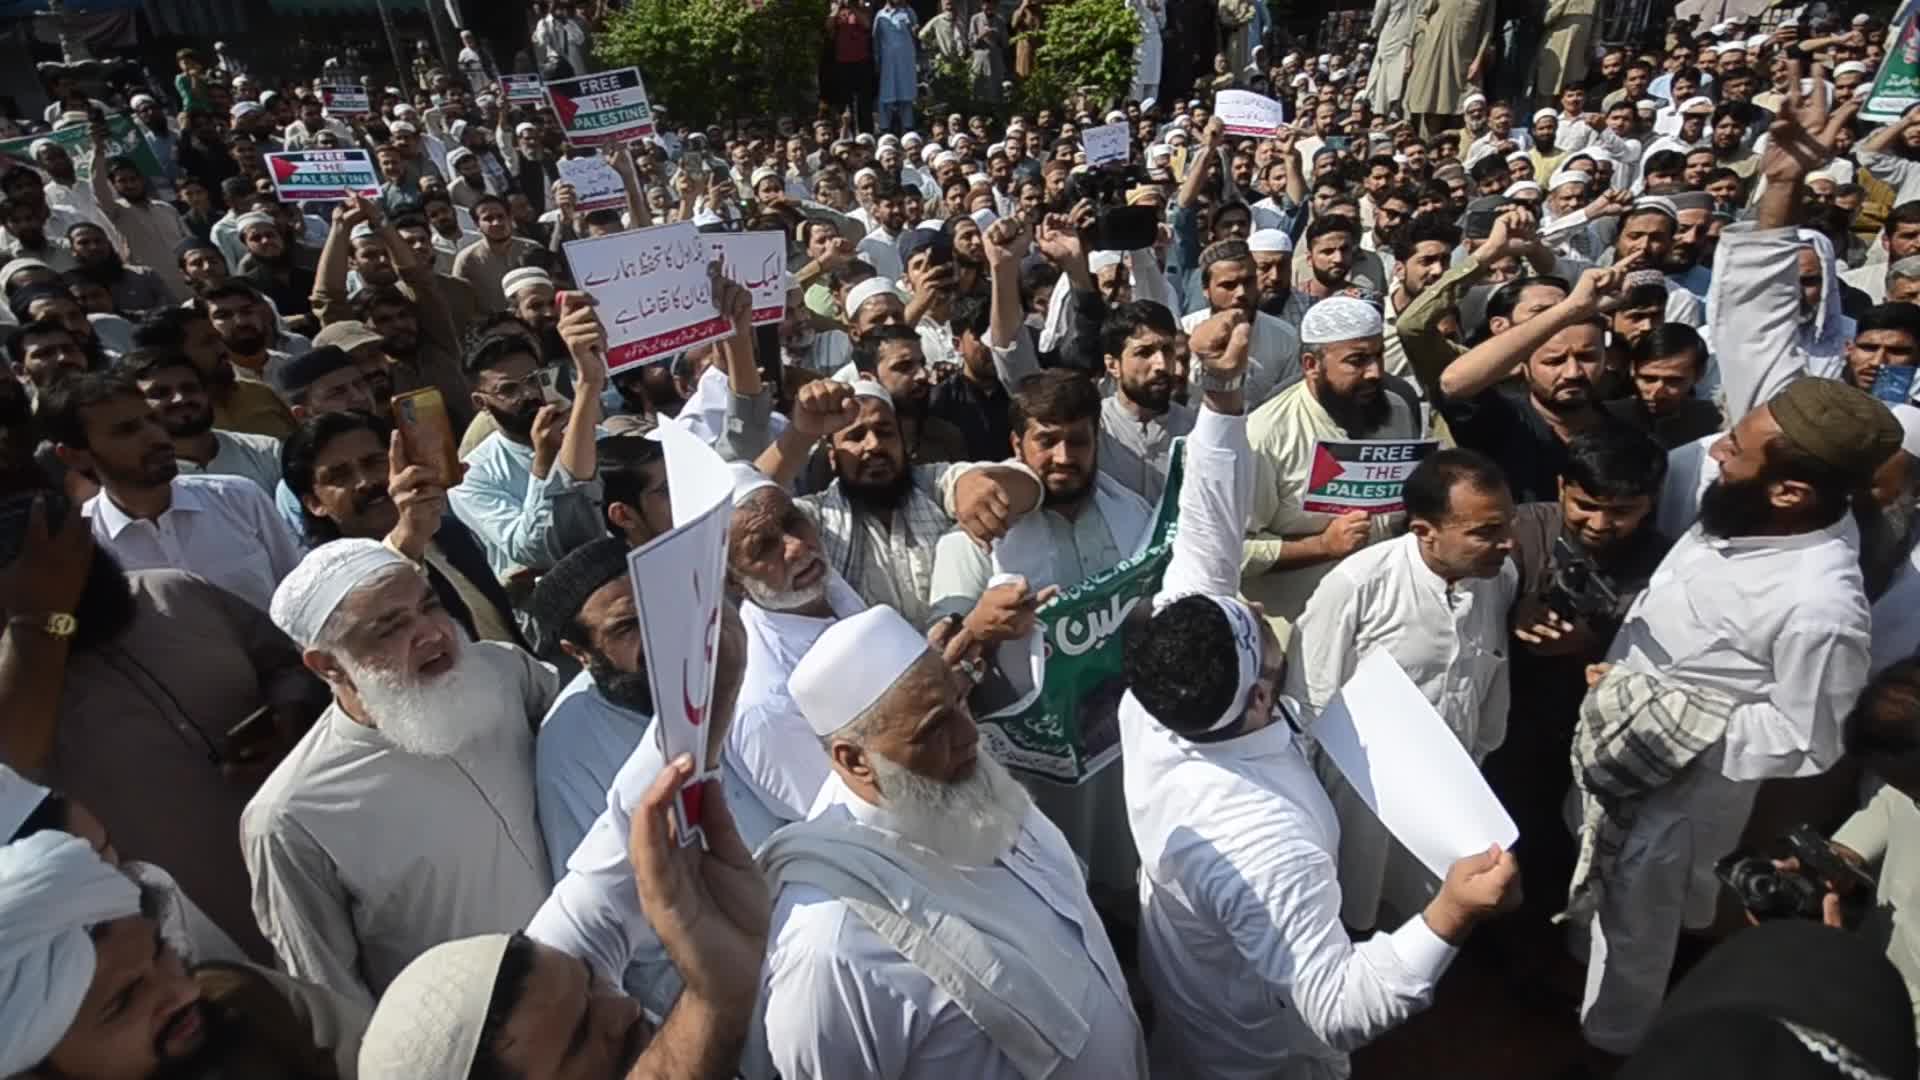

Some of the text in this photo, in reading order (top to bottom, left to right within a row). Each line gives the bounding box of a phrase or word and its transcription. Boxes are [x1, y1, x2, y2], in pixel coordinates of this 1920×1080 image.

[579, 75, 621, 94] FREE
[591, 93, 621, 110] THE
[574, 104, 646, 129] PALESTINE
[303, 152, 346, 161] FREE
[313, 163, 342, 172] THE
[290, 174, 371, 185] PALESTINE
[1359, 445, 1415, 461] FREE
[1365, 466, 1403, 480] THE
[1325, 482, 1404, 498] PALESTI
